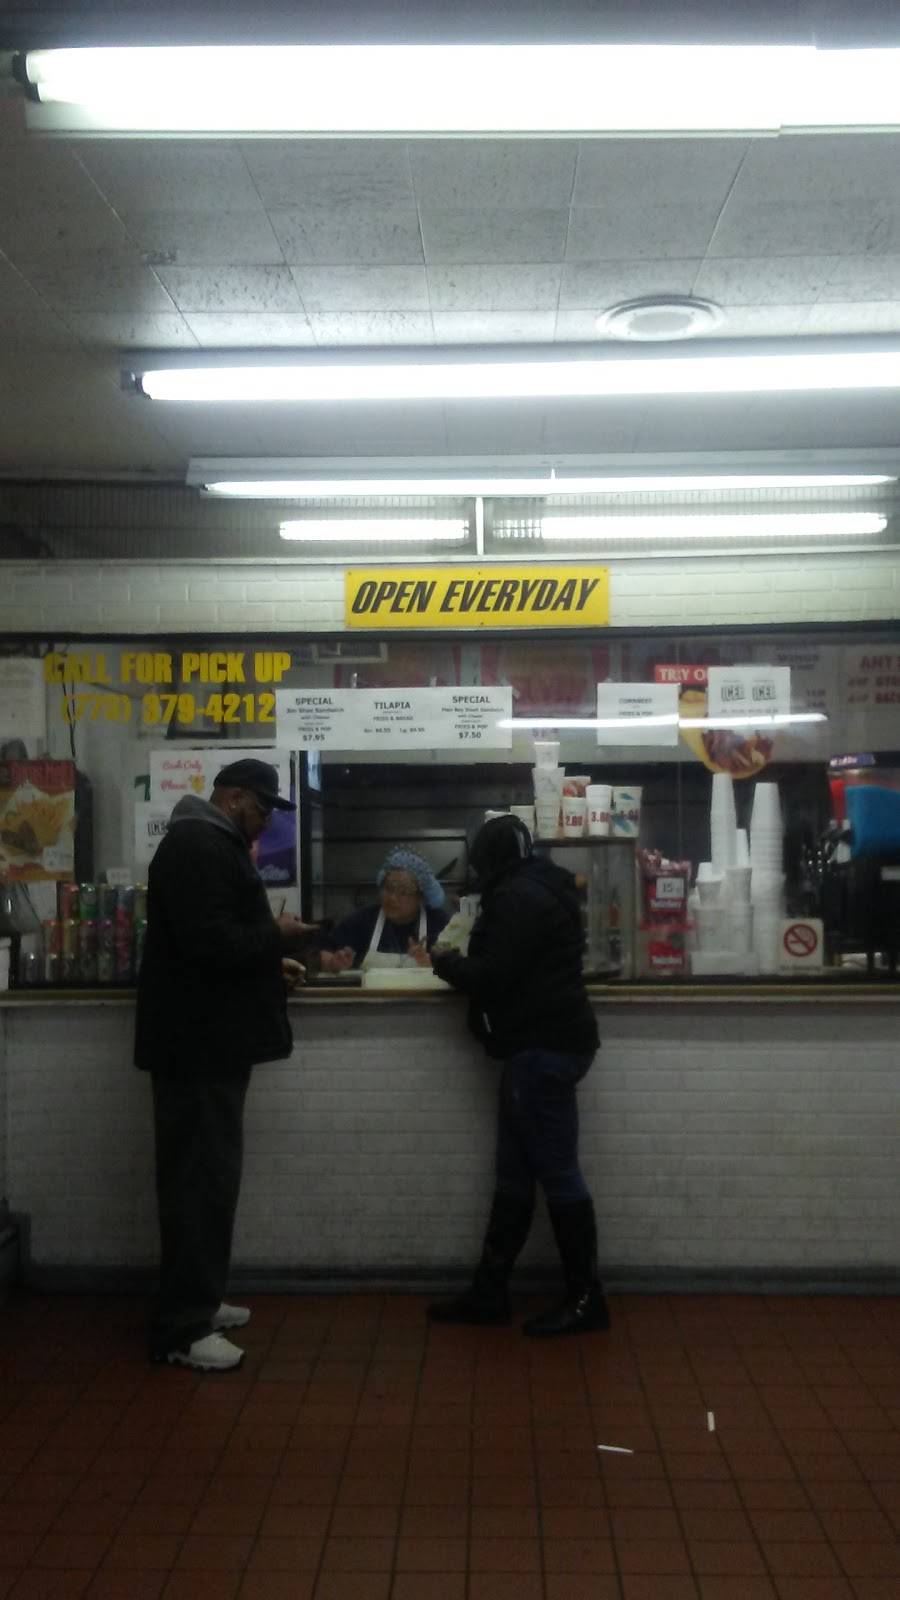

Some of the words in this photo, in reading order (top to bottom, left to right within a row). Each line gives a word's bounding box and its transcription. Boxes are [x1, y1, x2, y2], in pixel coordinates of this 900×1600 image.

[351, 581, 437, 614] OPEN
[439, 578, 600, 613] EVERYDAY
[43, 652, 113, 685] CALL
[121, 652, 173, 684] FOR
[182, 652, 246, 684] PICK
[254, 652, 292, 683] UP
[659, 668, 690, 682] TRY
[295, 697, 333, 706] SPECIAL
[452, 695, 491, 704] SPECIAL
[374, 701, 412, 710] TILAPIA
